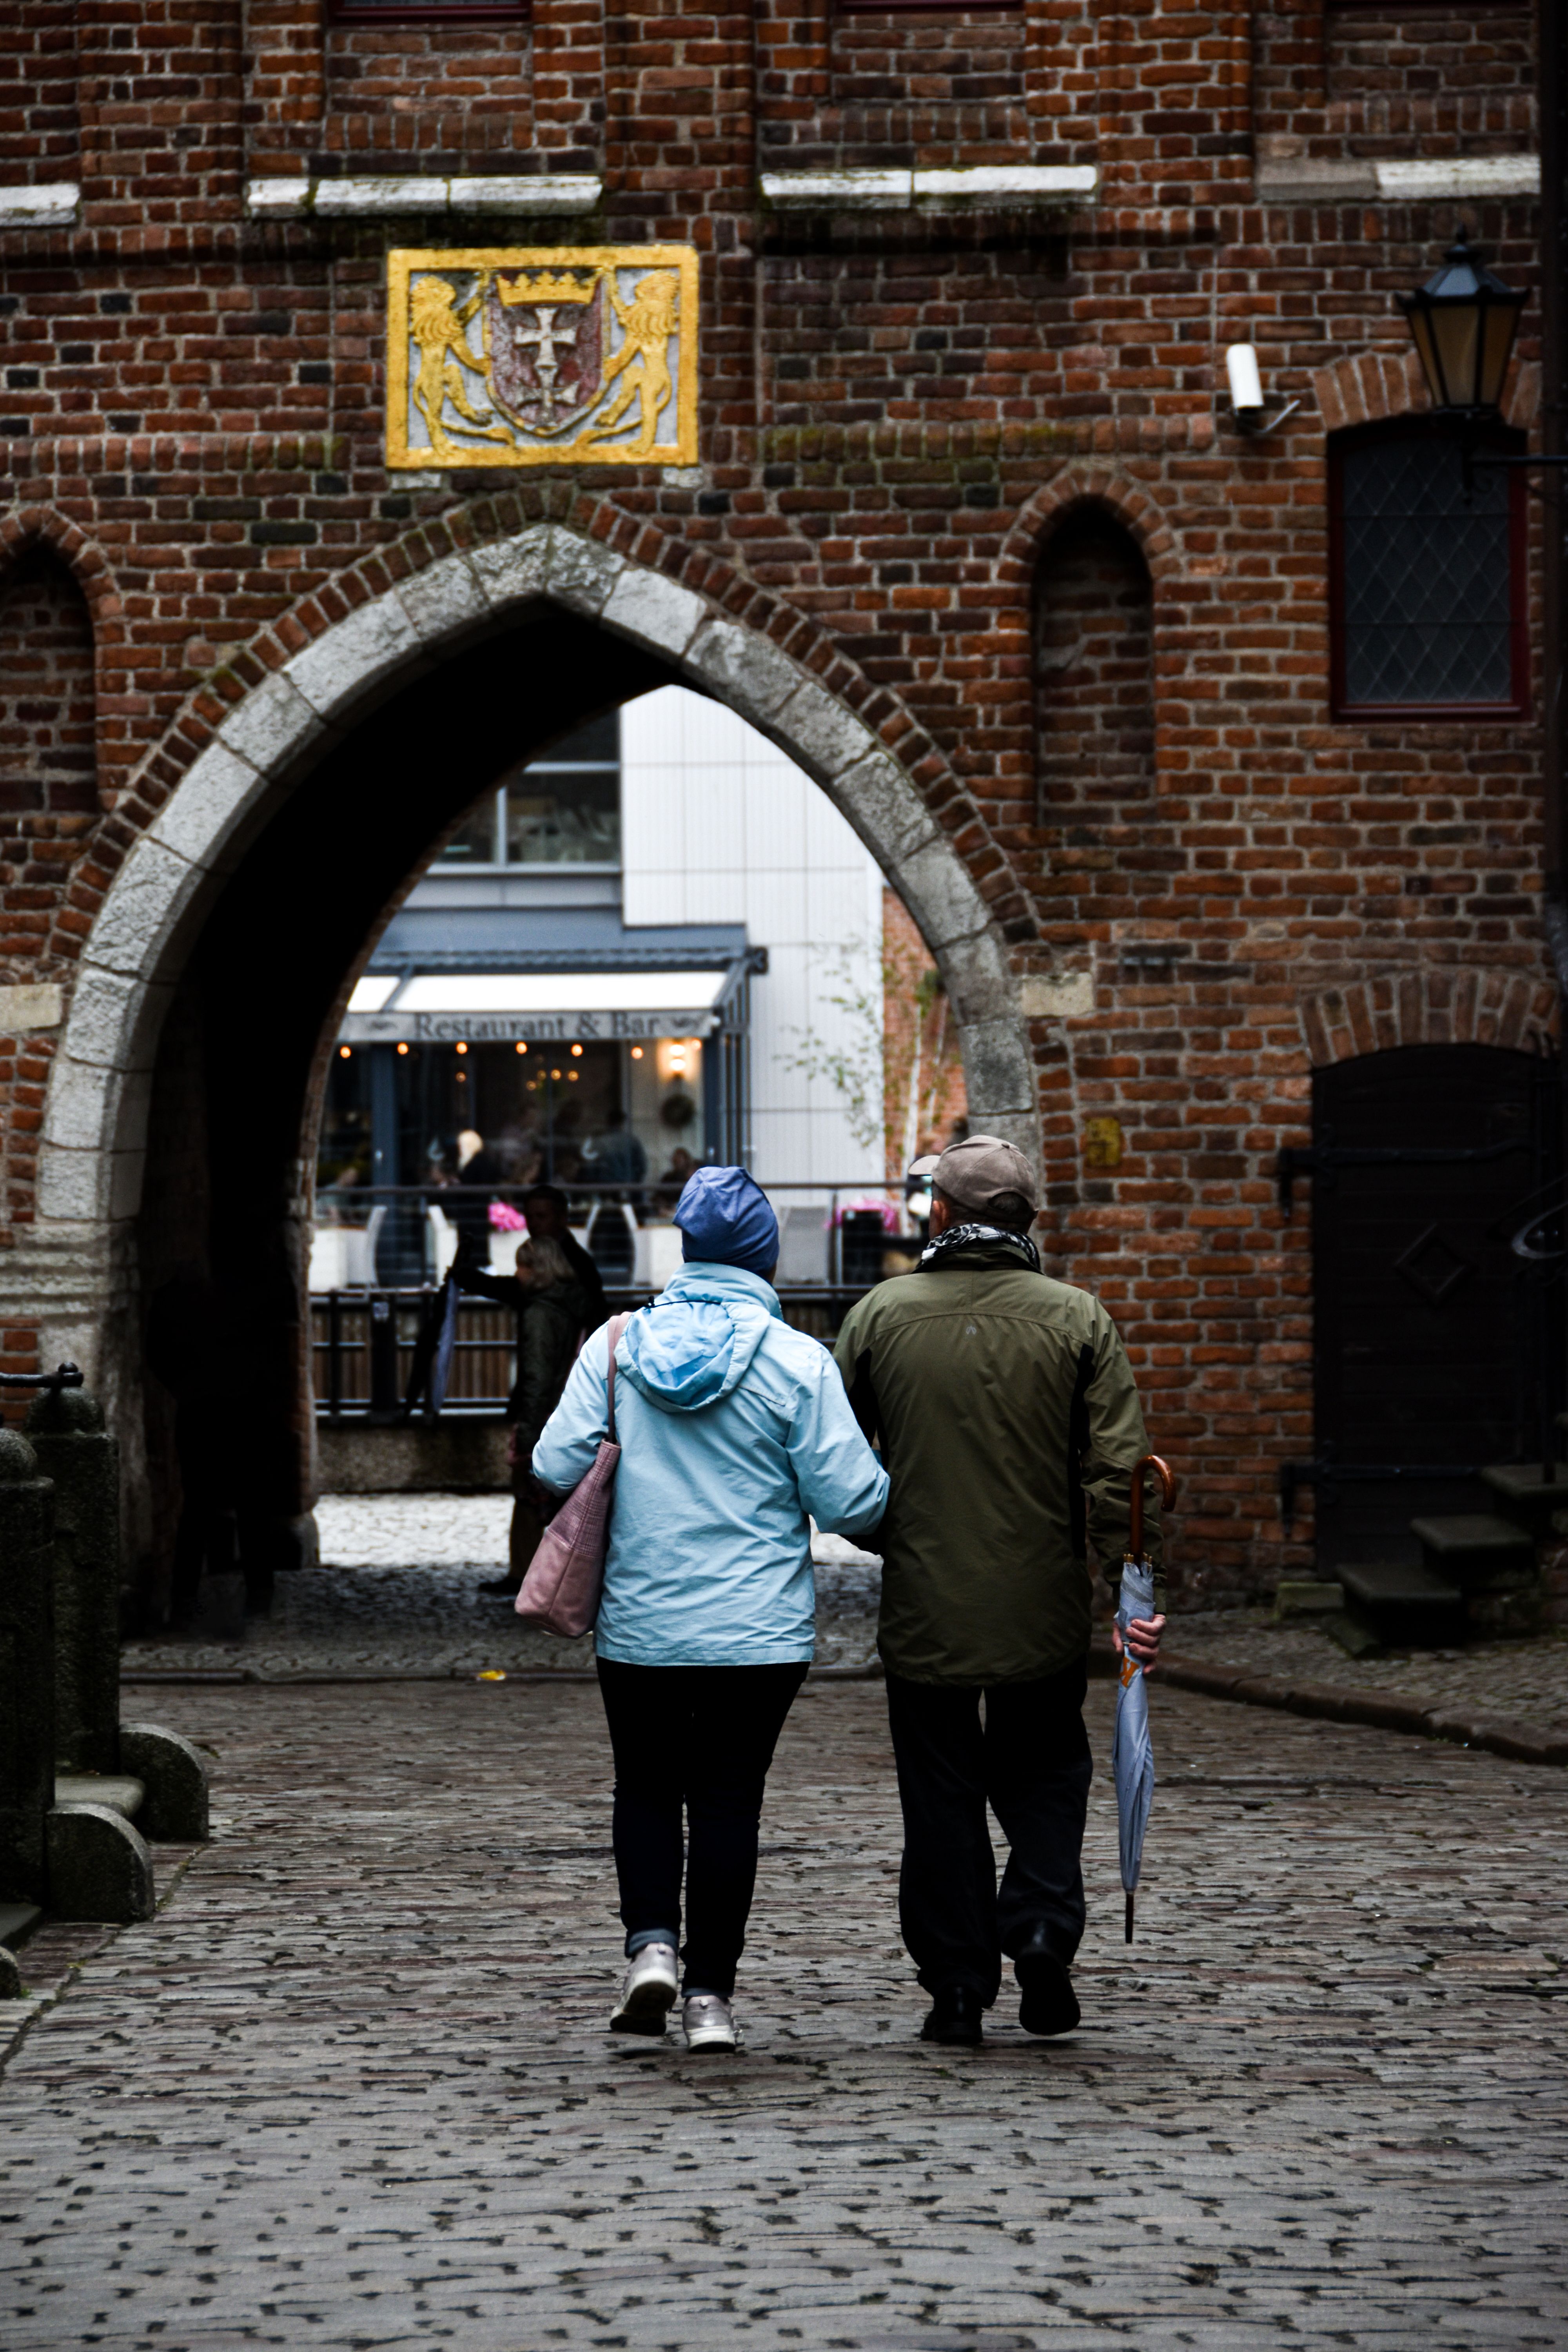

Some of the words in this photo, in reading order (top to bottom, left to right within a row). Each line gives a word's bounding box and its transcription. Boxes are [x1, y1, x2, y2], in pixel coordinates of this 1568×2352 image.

[414, 1011, 564, 1039] Restaurant
[576, 1010, 600, 1038] &
[611, 1010, 659, 1037] Bar
